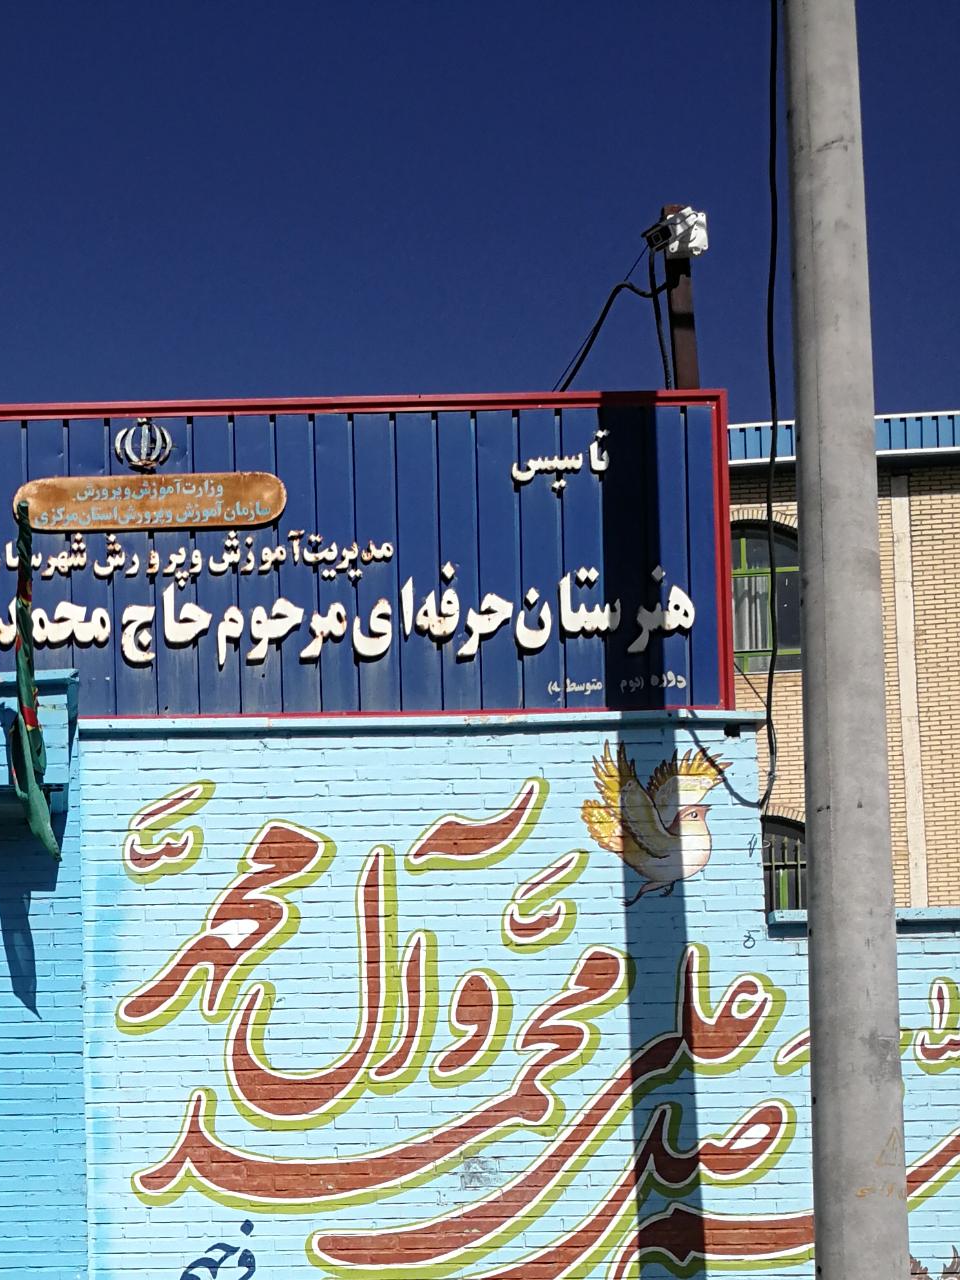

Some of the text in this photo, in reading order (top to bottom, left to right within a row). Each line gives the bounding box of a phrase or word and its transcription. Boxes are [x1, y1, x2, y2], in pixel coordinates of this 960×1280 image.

[76, 481, 122, 501] پرورش
[132, 479, 183, 501] آموزش
[183, 479, 224, 498] وزارت
[35, 507, 78, 527] مرکزی
[79, 505, 118, 526] استان
[118, 505, 163, 525] پرورش
[176, 500, 224, 523] آموزش
[224, 500, 271, 522] سازمان
[94, 532, 186, 586] پرورش
[209, 530, 305, 573] آموزش
[304, 533, 394, 578] مدیریت
[515, 564, 696, 653] هنرستان
[122, 582, 213, 663] حاج
[218, 597, 347, 666] مرحوم
